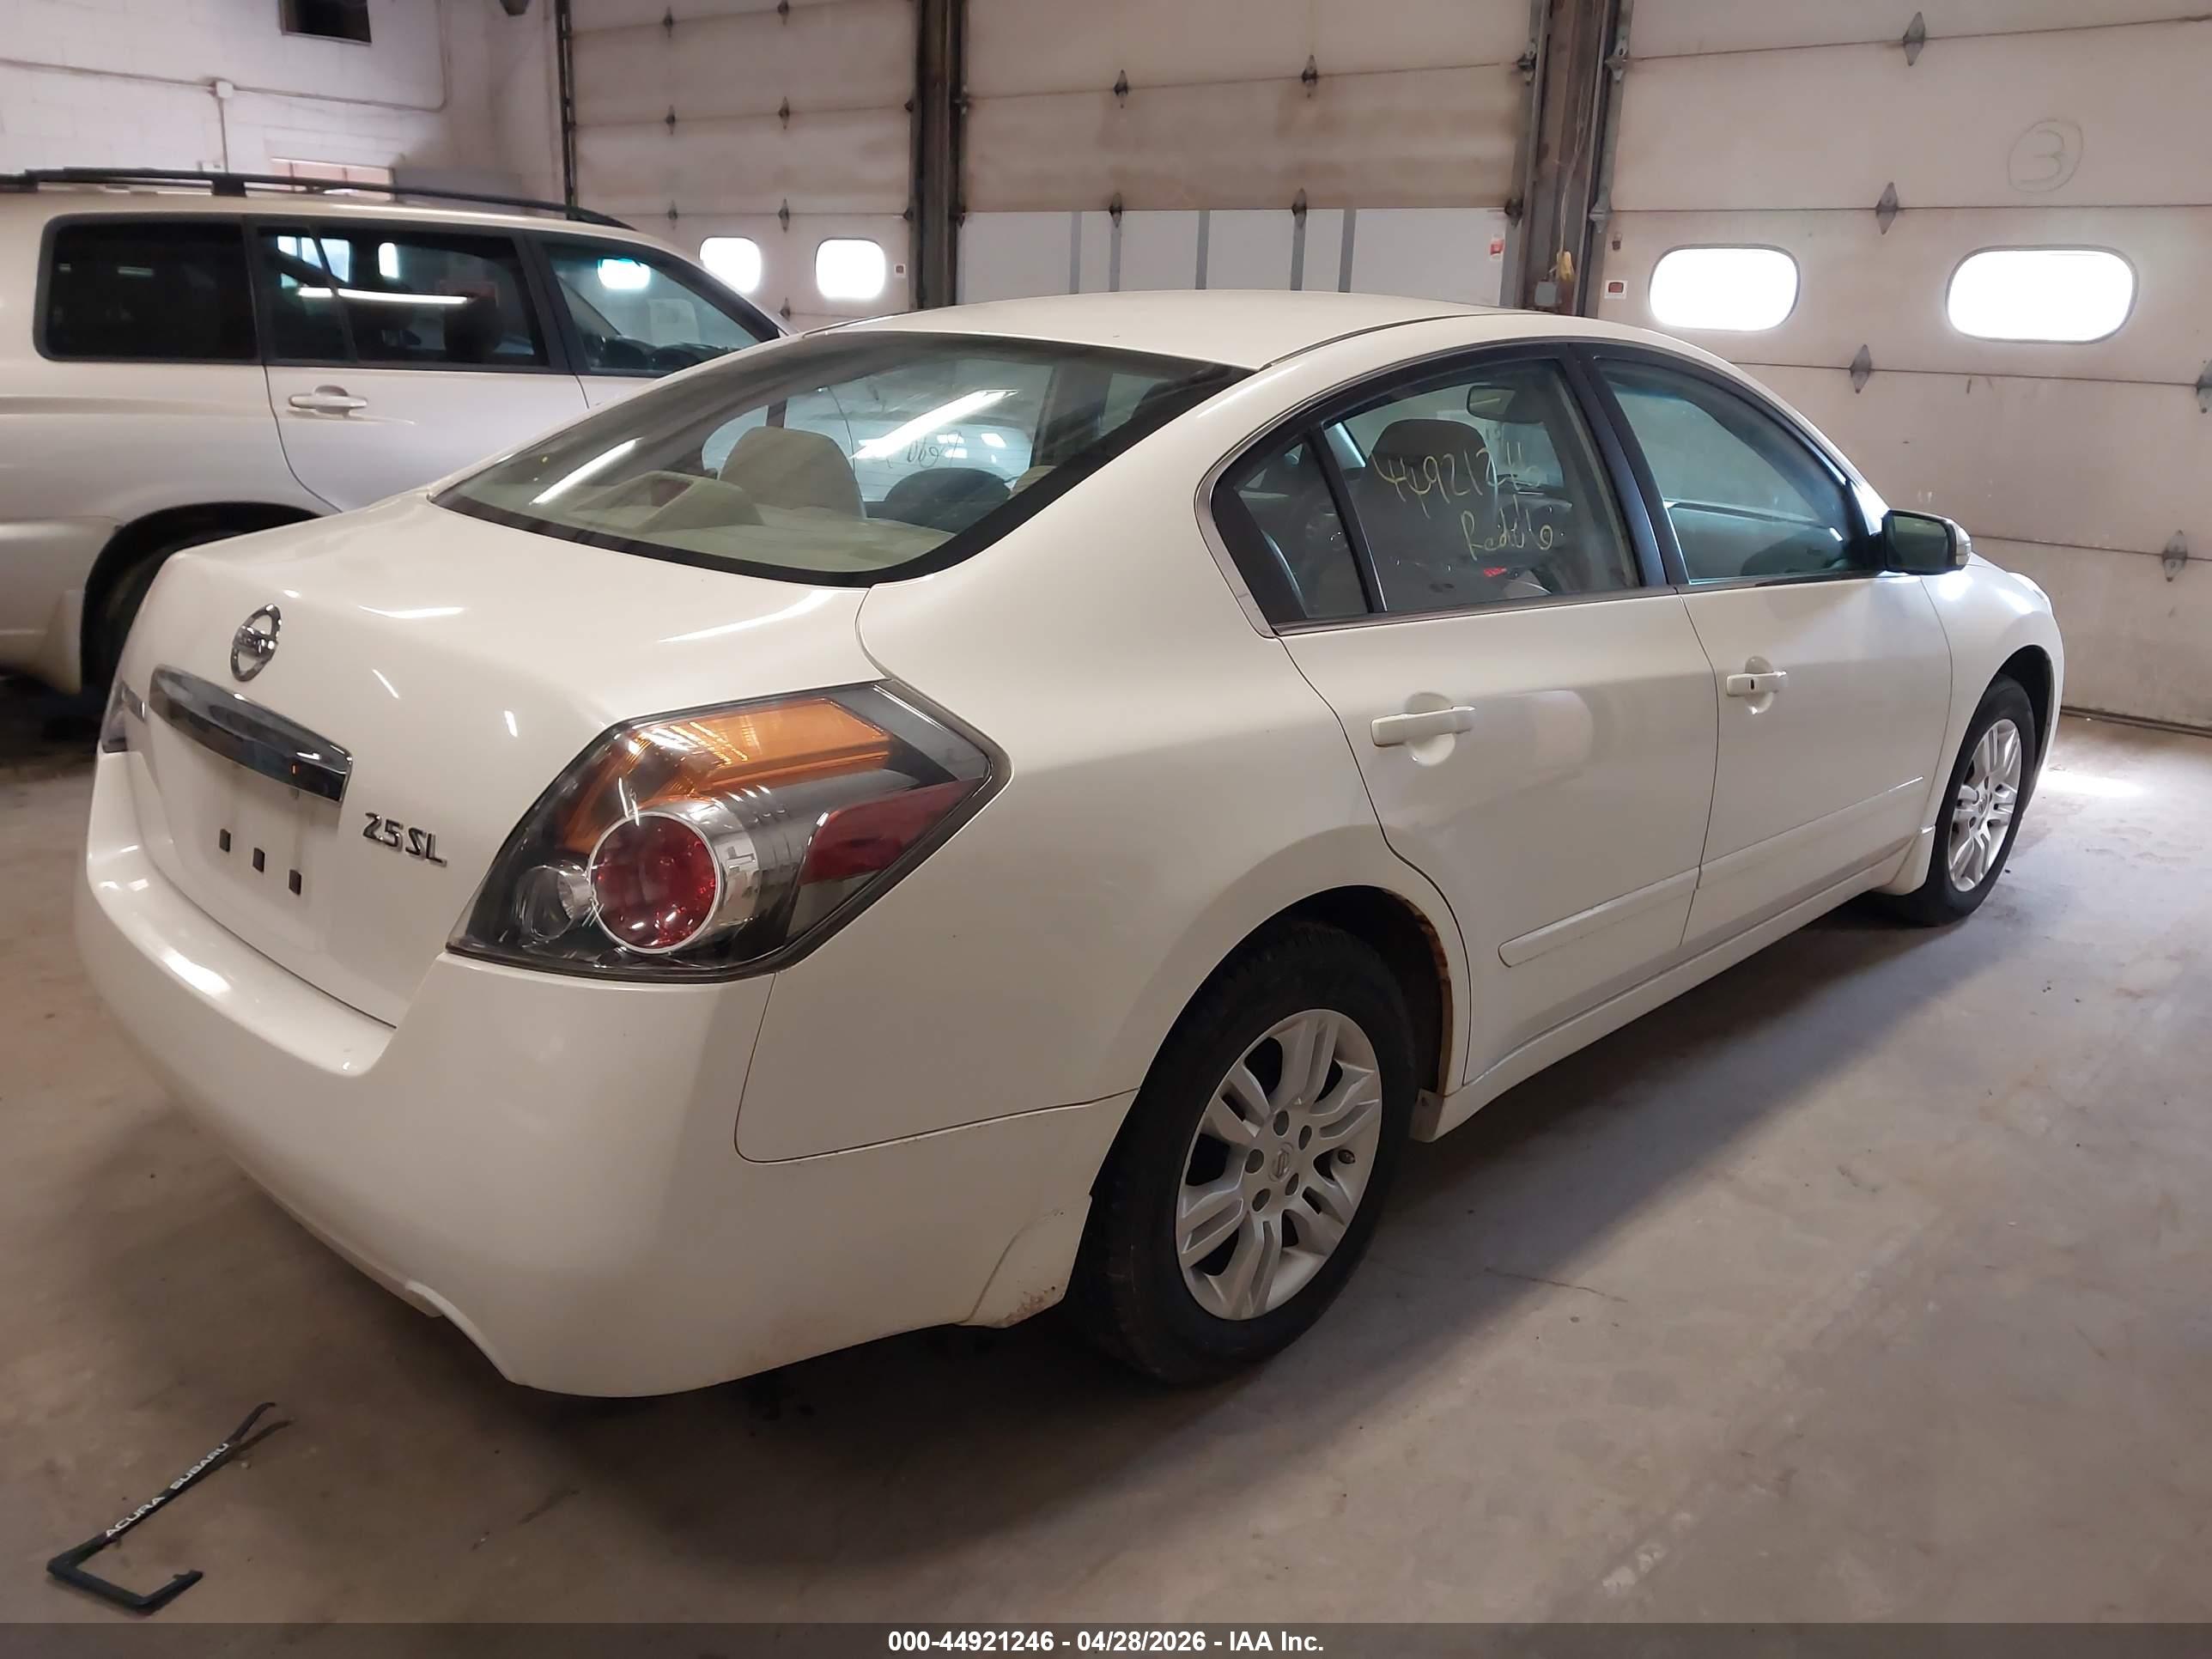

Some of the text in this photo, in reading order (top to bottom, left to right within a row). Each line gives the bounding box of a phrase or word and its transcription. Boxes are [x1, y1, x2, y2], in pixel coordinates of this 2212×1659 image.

[2020, 129, 2065, 184] 3
[106, 1443, 229, 1537] ACURA SUBARU
